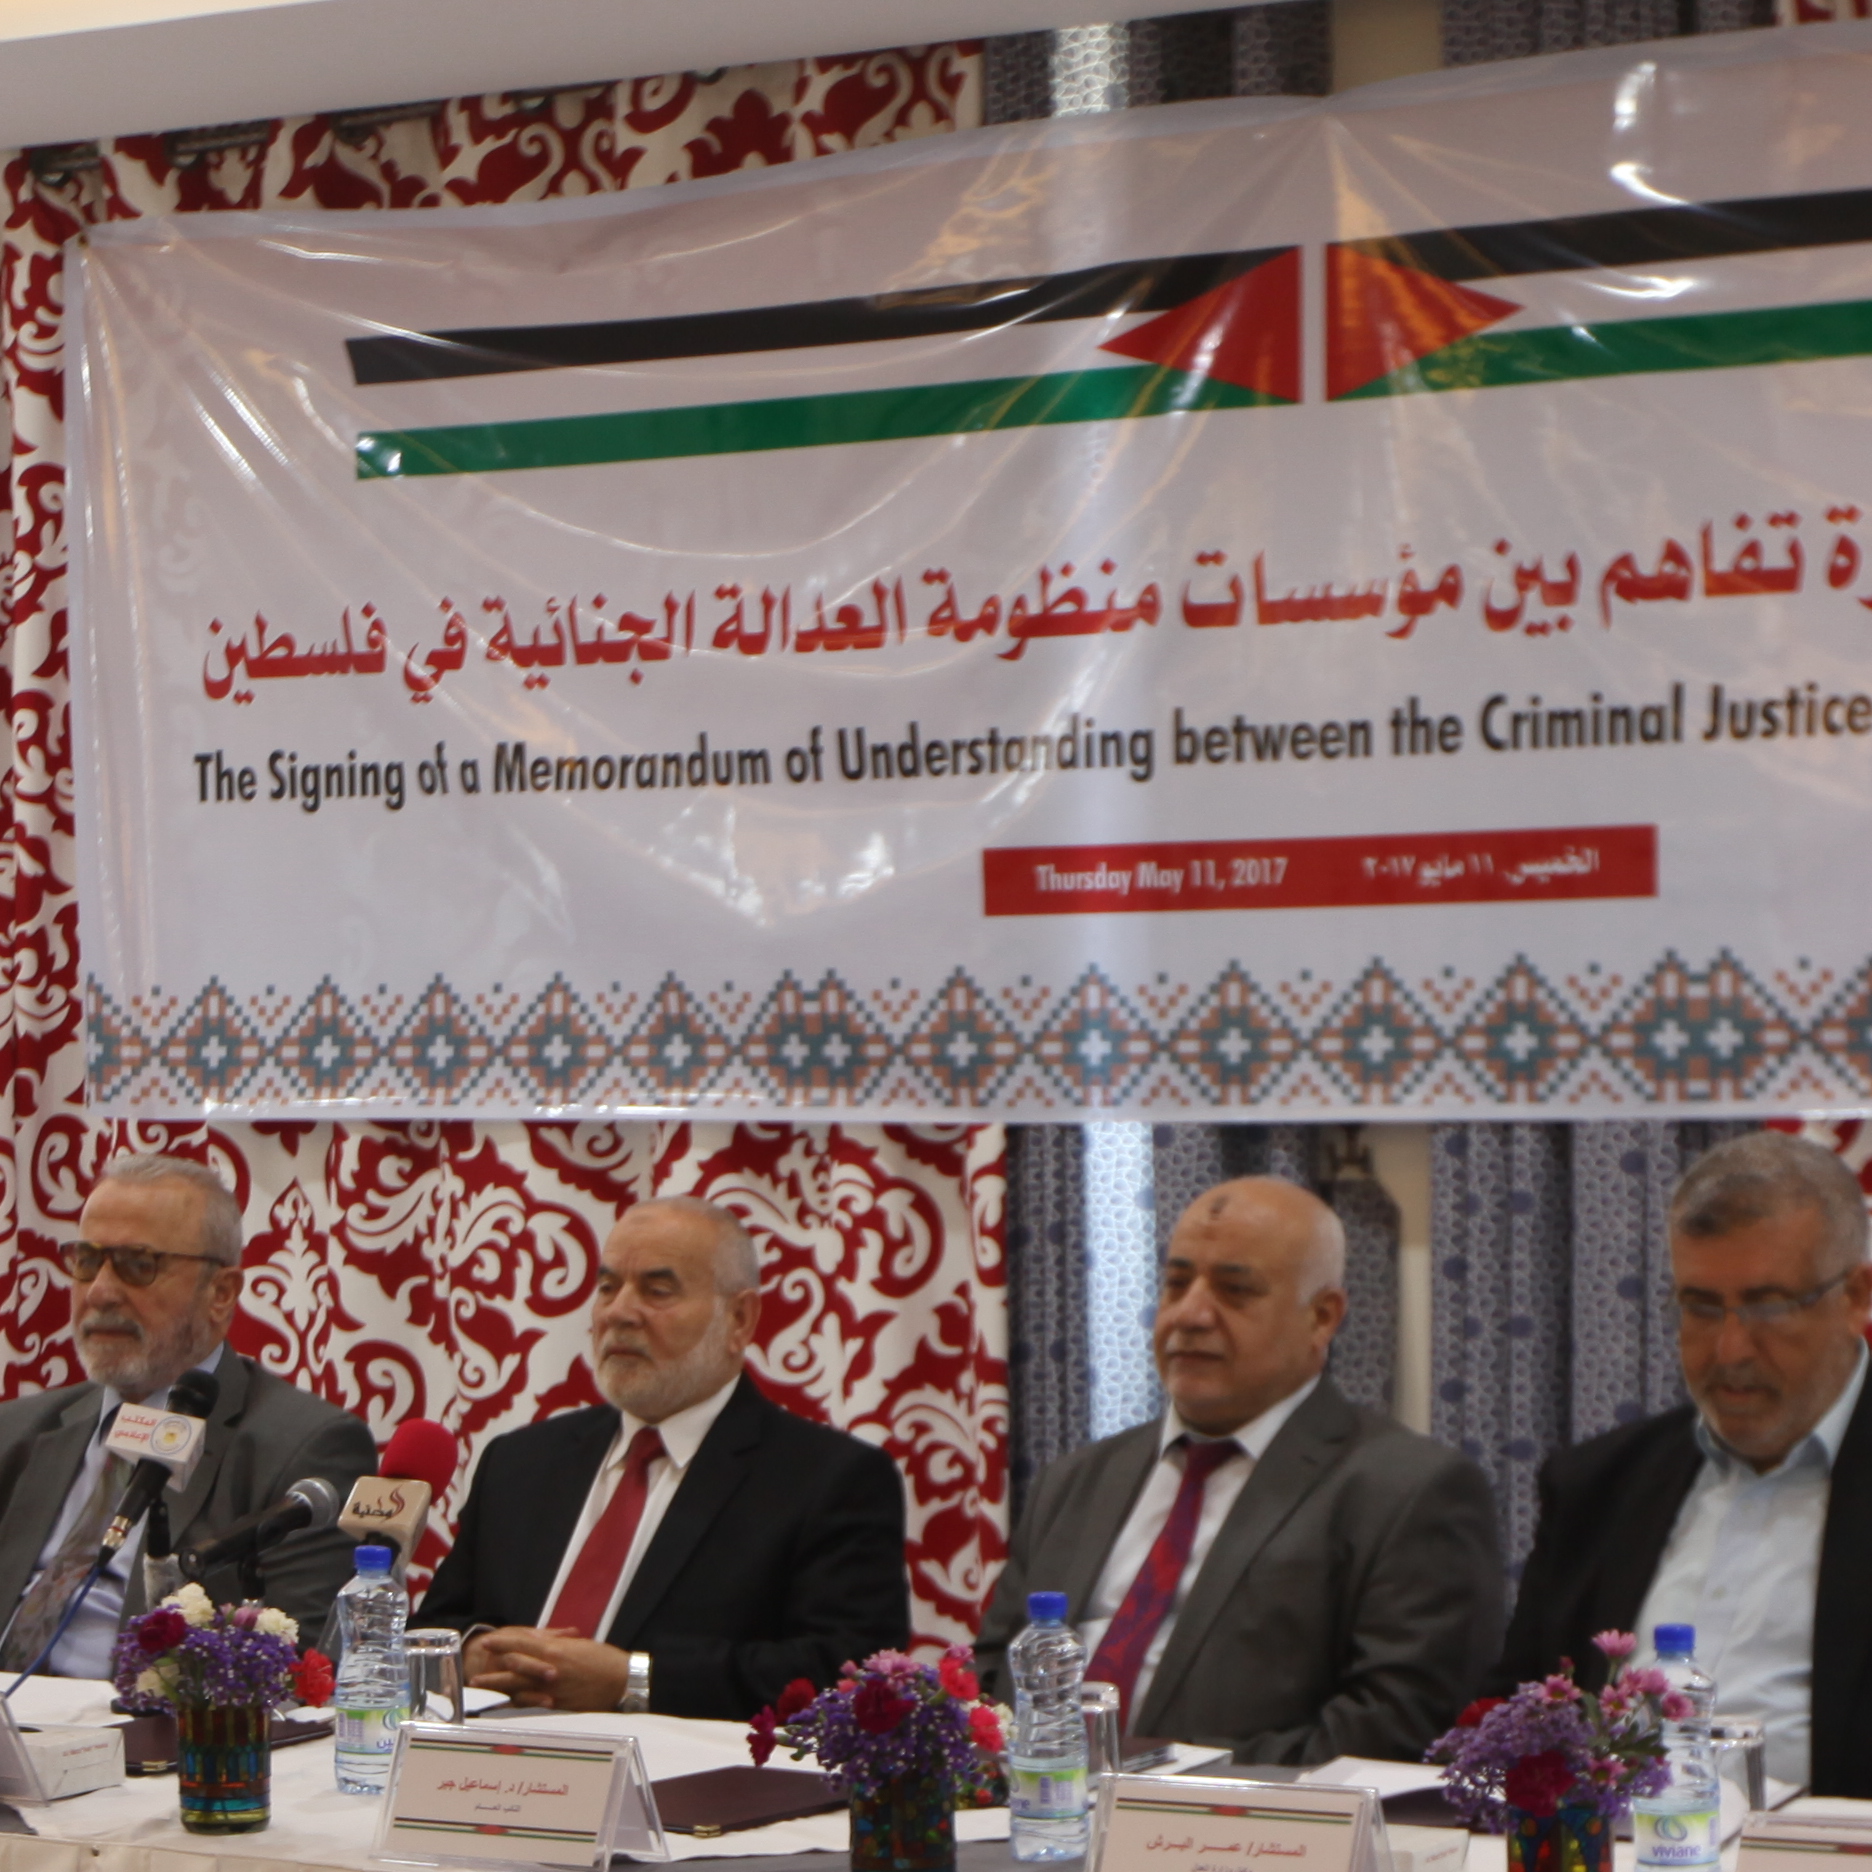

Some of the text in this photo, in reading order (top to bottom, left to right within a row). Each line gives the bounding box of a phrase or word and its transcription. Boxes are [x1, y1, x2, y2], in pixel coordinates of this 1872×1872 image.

[921, 560, 1161, 661] منظومة
[1181, 550, 1463, 640] مؤسسات
[1483, 541, 1580, 635] بين
[1600, 513, 1804, 624] تفاهم
[203, 604, 387, 705] فلسطين
[403, 598, 468, 704] في
[482, 594, 695, 690] الجنائية
[711, 580, 907, 656] العدالة
[193, 748, 258, 803] The
[267, 749, 406, 814] Signing
[416, 740, 450, 796] of
[459, 759, 482, 796] a
[493, 731, 773, 794] Memorandum
[784, 724, 825, 784] of
[836, 715, 1156, 783] Understanding
[1173, 705, 1374, 766] between
[1389, 696, 1464, 756] the
[1478, 681, 1685, 752] Criminal
[1034, 856, 1289, 896] Thursday May 11, 2017
[1419, 853, 1465, 887] مايو
